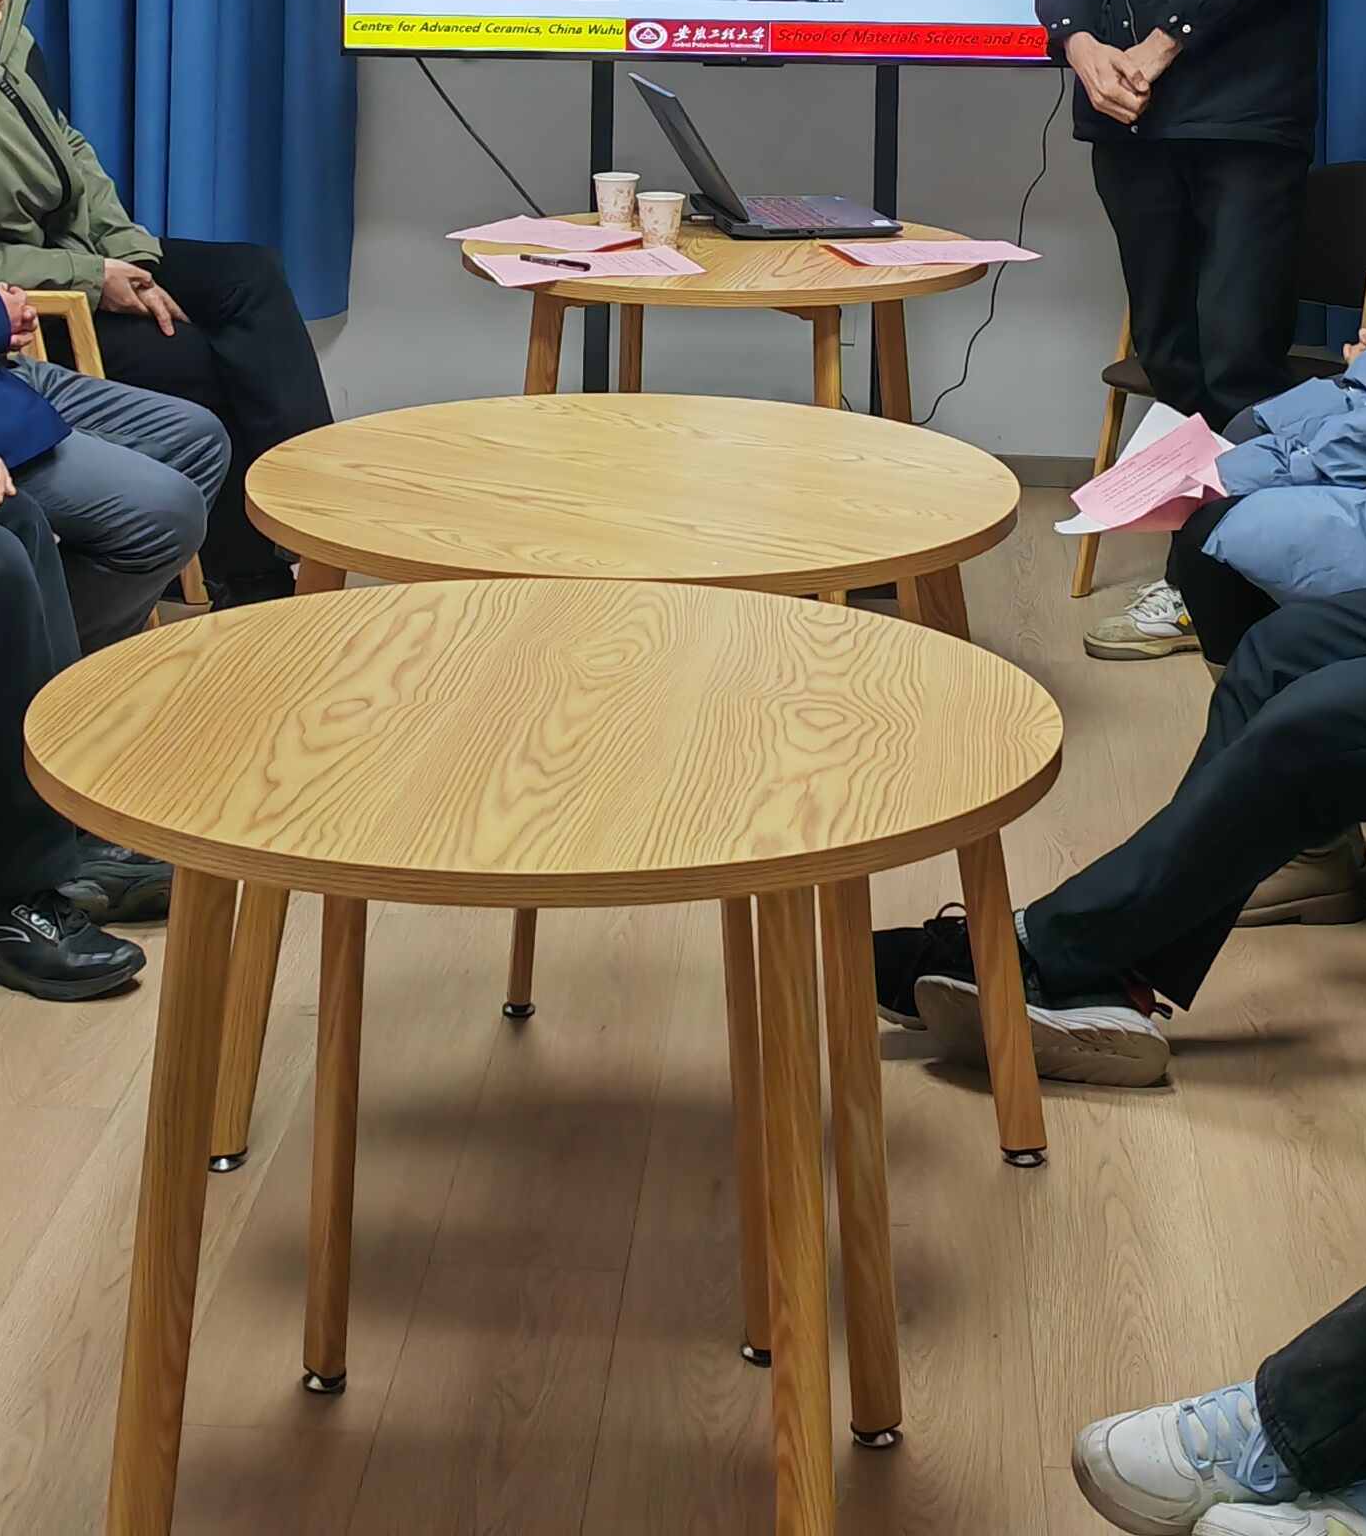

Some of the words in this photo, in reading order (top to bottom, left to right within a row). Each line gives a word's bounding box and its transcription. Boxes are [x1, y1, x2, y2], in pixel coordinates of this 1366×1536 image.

[352, 20, 394, 33] Centre
[398, 21, 416, 34] for
[420, 21, 481, 34] Advanced
[485, 22, 543, 36] Ceramics,
[548, 23, 583, 36] China
[588, 24, 624, 37] Wuhu
[777, 28, 828, 43] School
[831, 28, 848, 43] of
[852, 30, 920, 45] Materials
[925, 31, 979, 46] Science
[983, 32, 1014, 46] and
[1017, 33, 1049, 49] Eng
